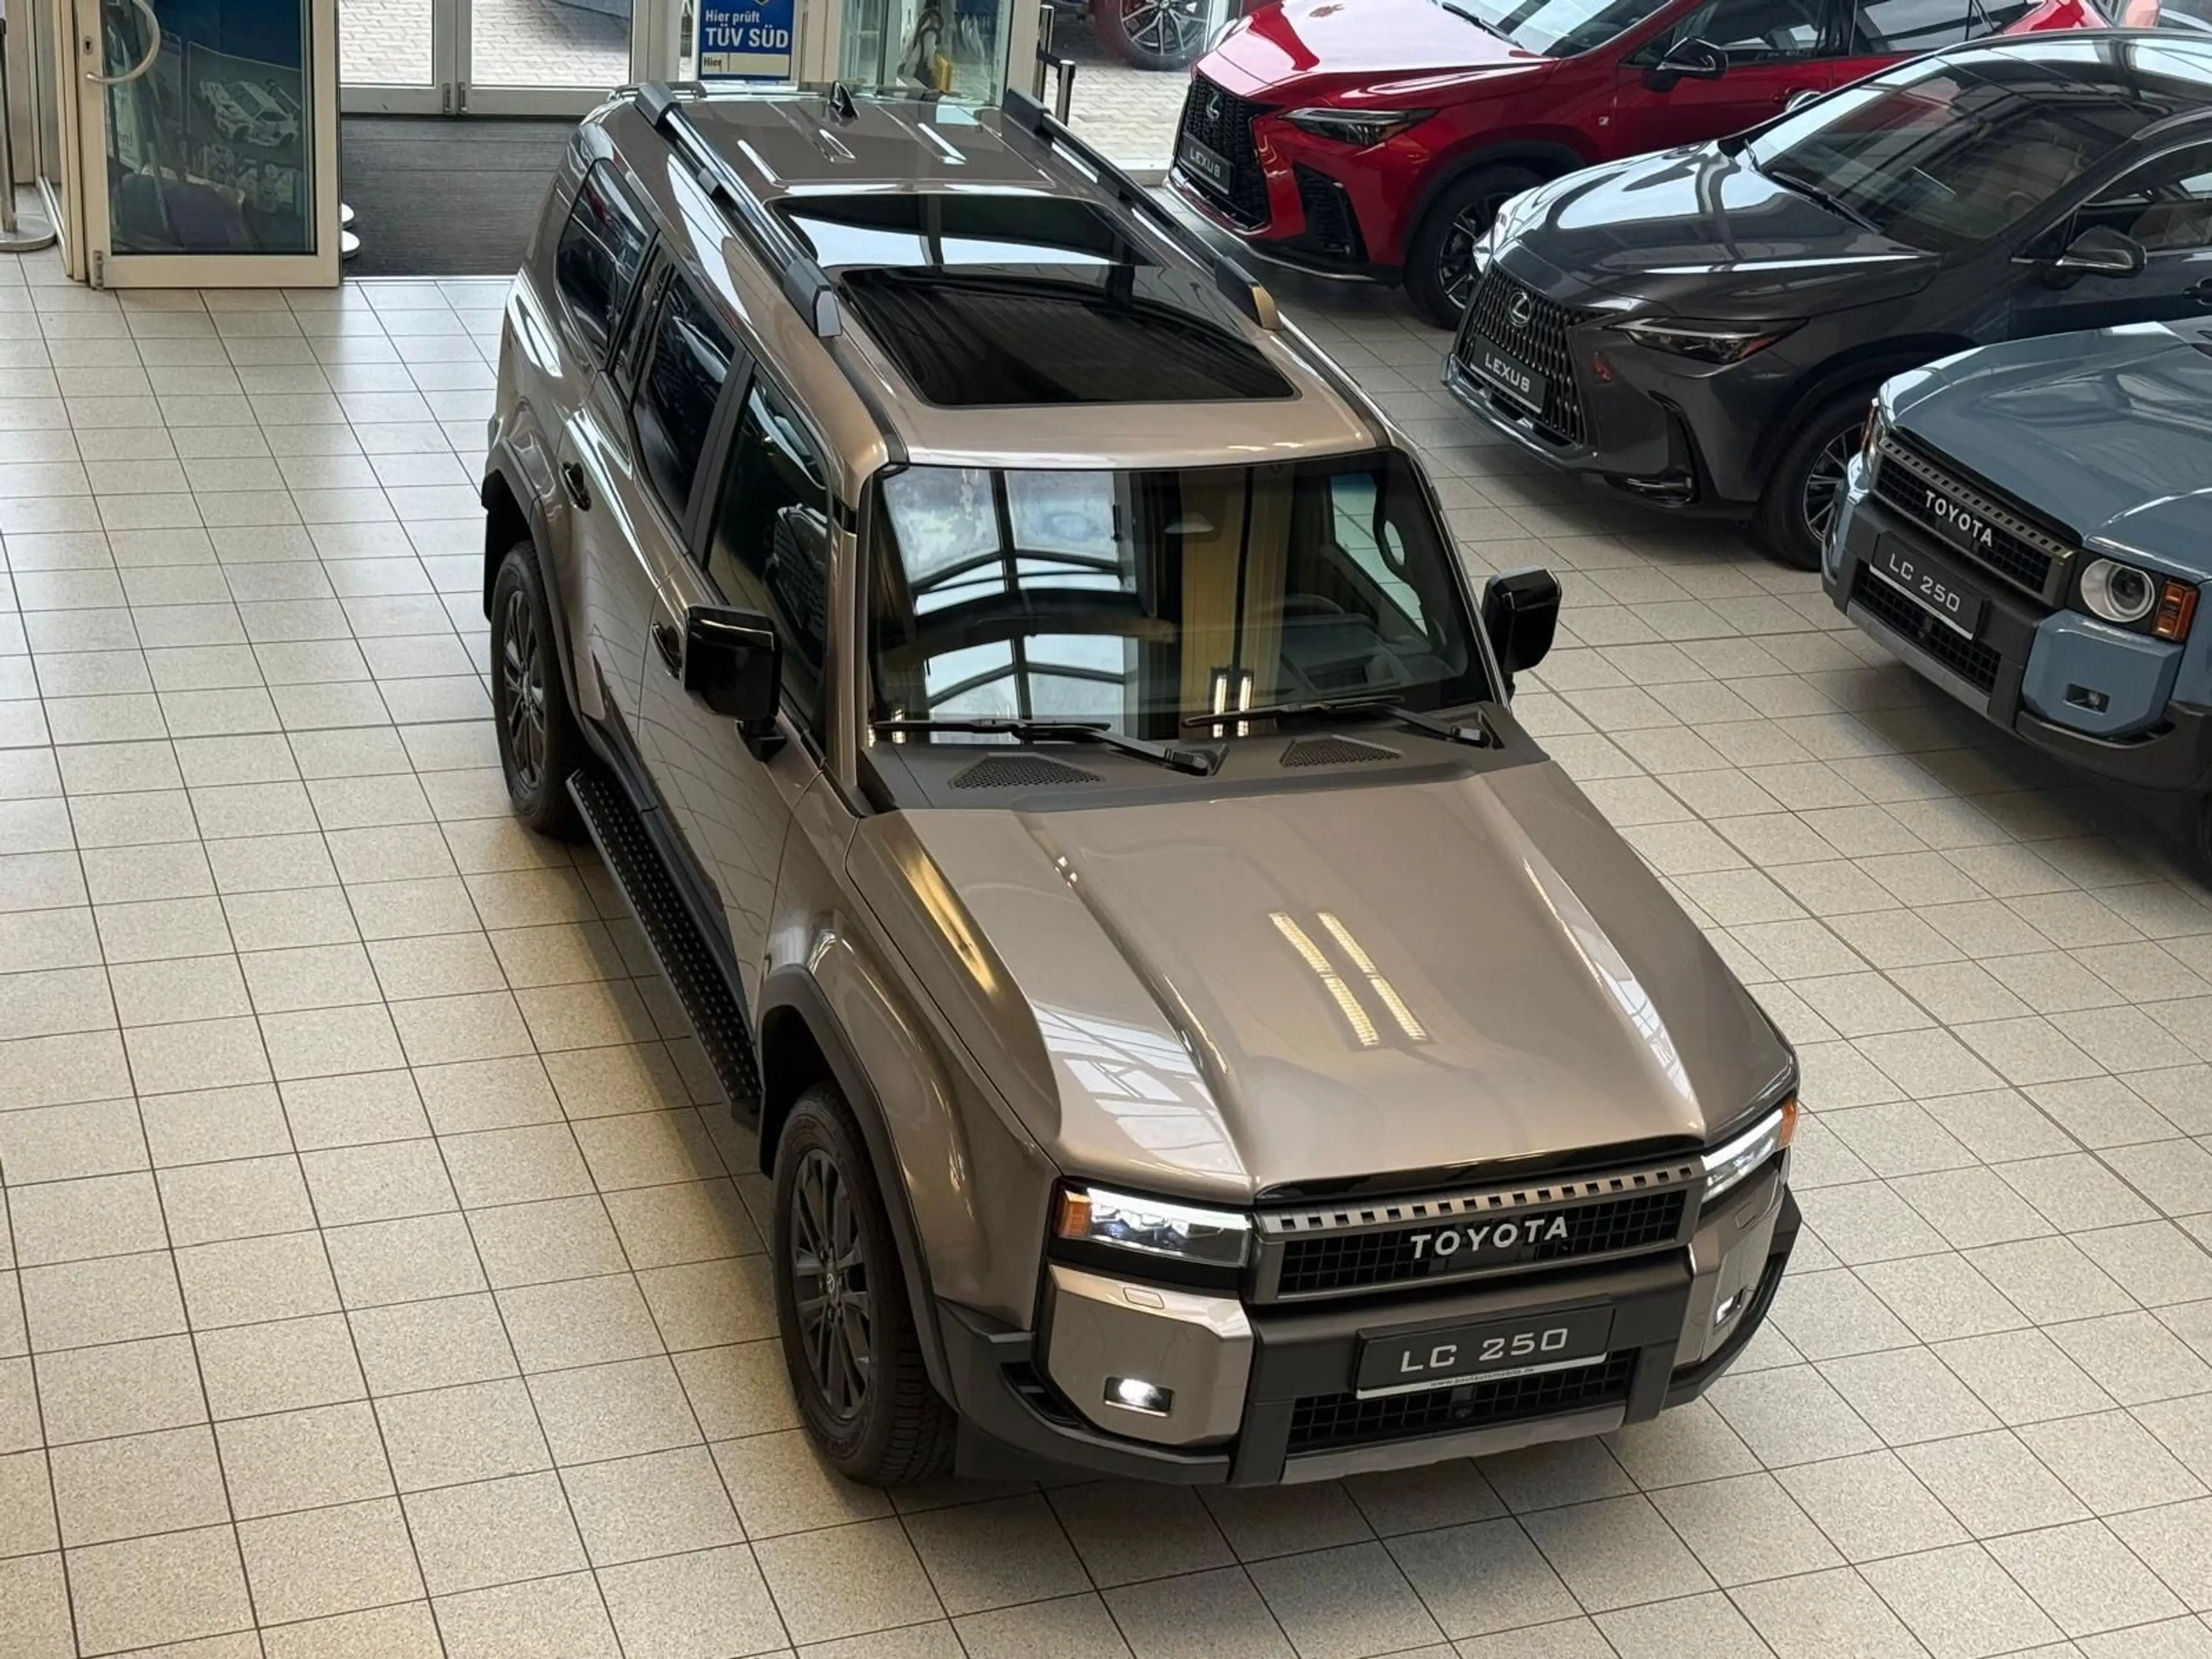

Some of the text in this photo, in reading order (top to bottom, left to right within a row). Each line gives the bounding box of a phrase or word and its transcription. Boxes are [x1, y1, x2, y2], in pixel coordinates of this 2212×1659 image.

[705, 9, 760, 25] Hier prüft
[705, 23, 789, 48] TÜV SÜD
[1926, 490, 1992, 547] TOYOTA
[1889, 553, 1960, 612] LC 250
[1410, 1217, 1568, 1259] TOYOTA
[1400, 1328, 1568, 1373] LC 250
